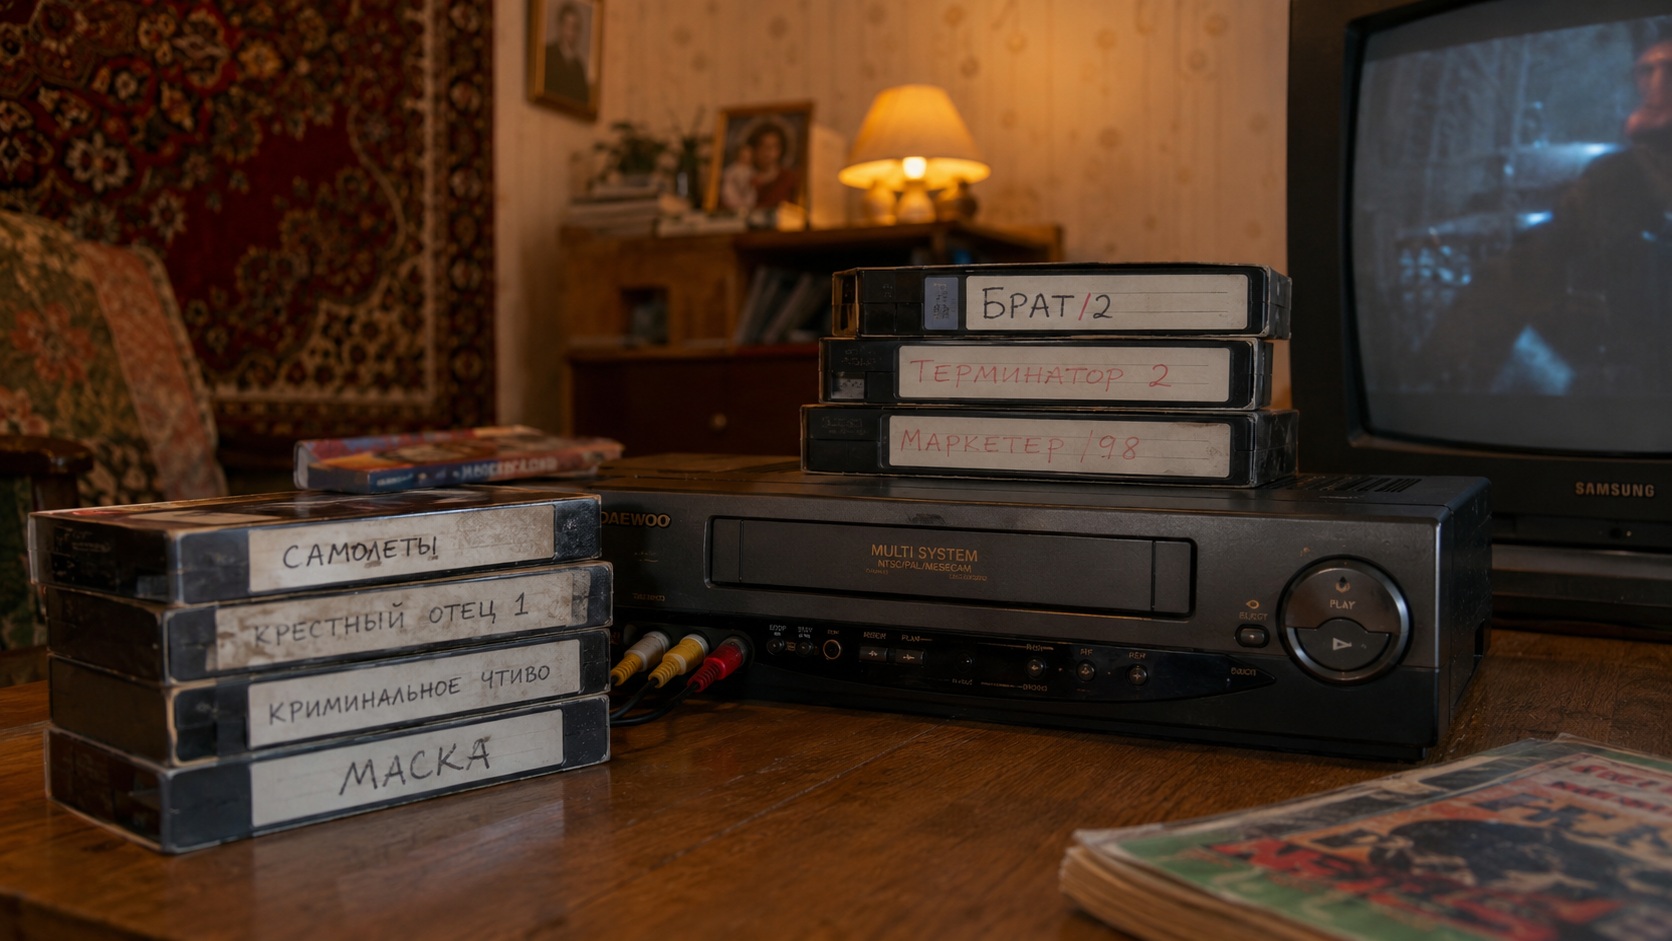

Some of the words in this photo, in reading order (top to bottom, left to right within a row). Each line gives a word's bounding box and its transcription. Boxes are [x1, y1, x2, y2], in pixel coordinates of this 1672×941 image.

[909, 359, 1124, 392] ТЕРМИНАТОР
[1149, 364, 1172, 388] 2
[900, 429, 1064, 463] МАРКЕТЕР
[1575, 481, 1655, 497] SAMSUNG
[601, 511, 671, 528] DAEWOO
[283, 536, 436, 569] САМОЛЕТЫ
[871, 544, 914, 558] MULTI
[918, 546, 978, 562] SYSTEM
[255, 602, 406, 646] КРЕСТНЫЙ
[428, 599, 497, 625] ОТЕЦ
[513, 592, 530, 617] 1
[1329, 599, 1356, 611] PLAY
[269, 676, 461, 726] КРИМИНАЛЬНОЕ
[480, 664, 551, 691] ЧТИВО
[338, 736, 492, 797] МАСКА
